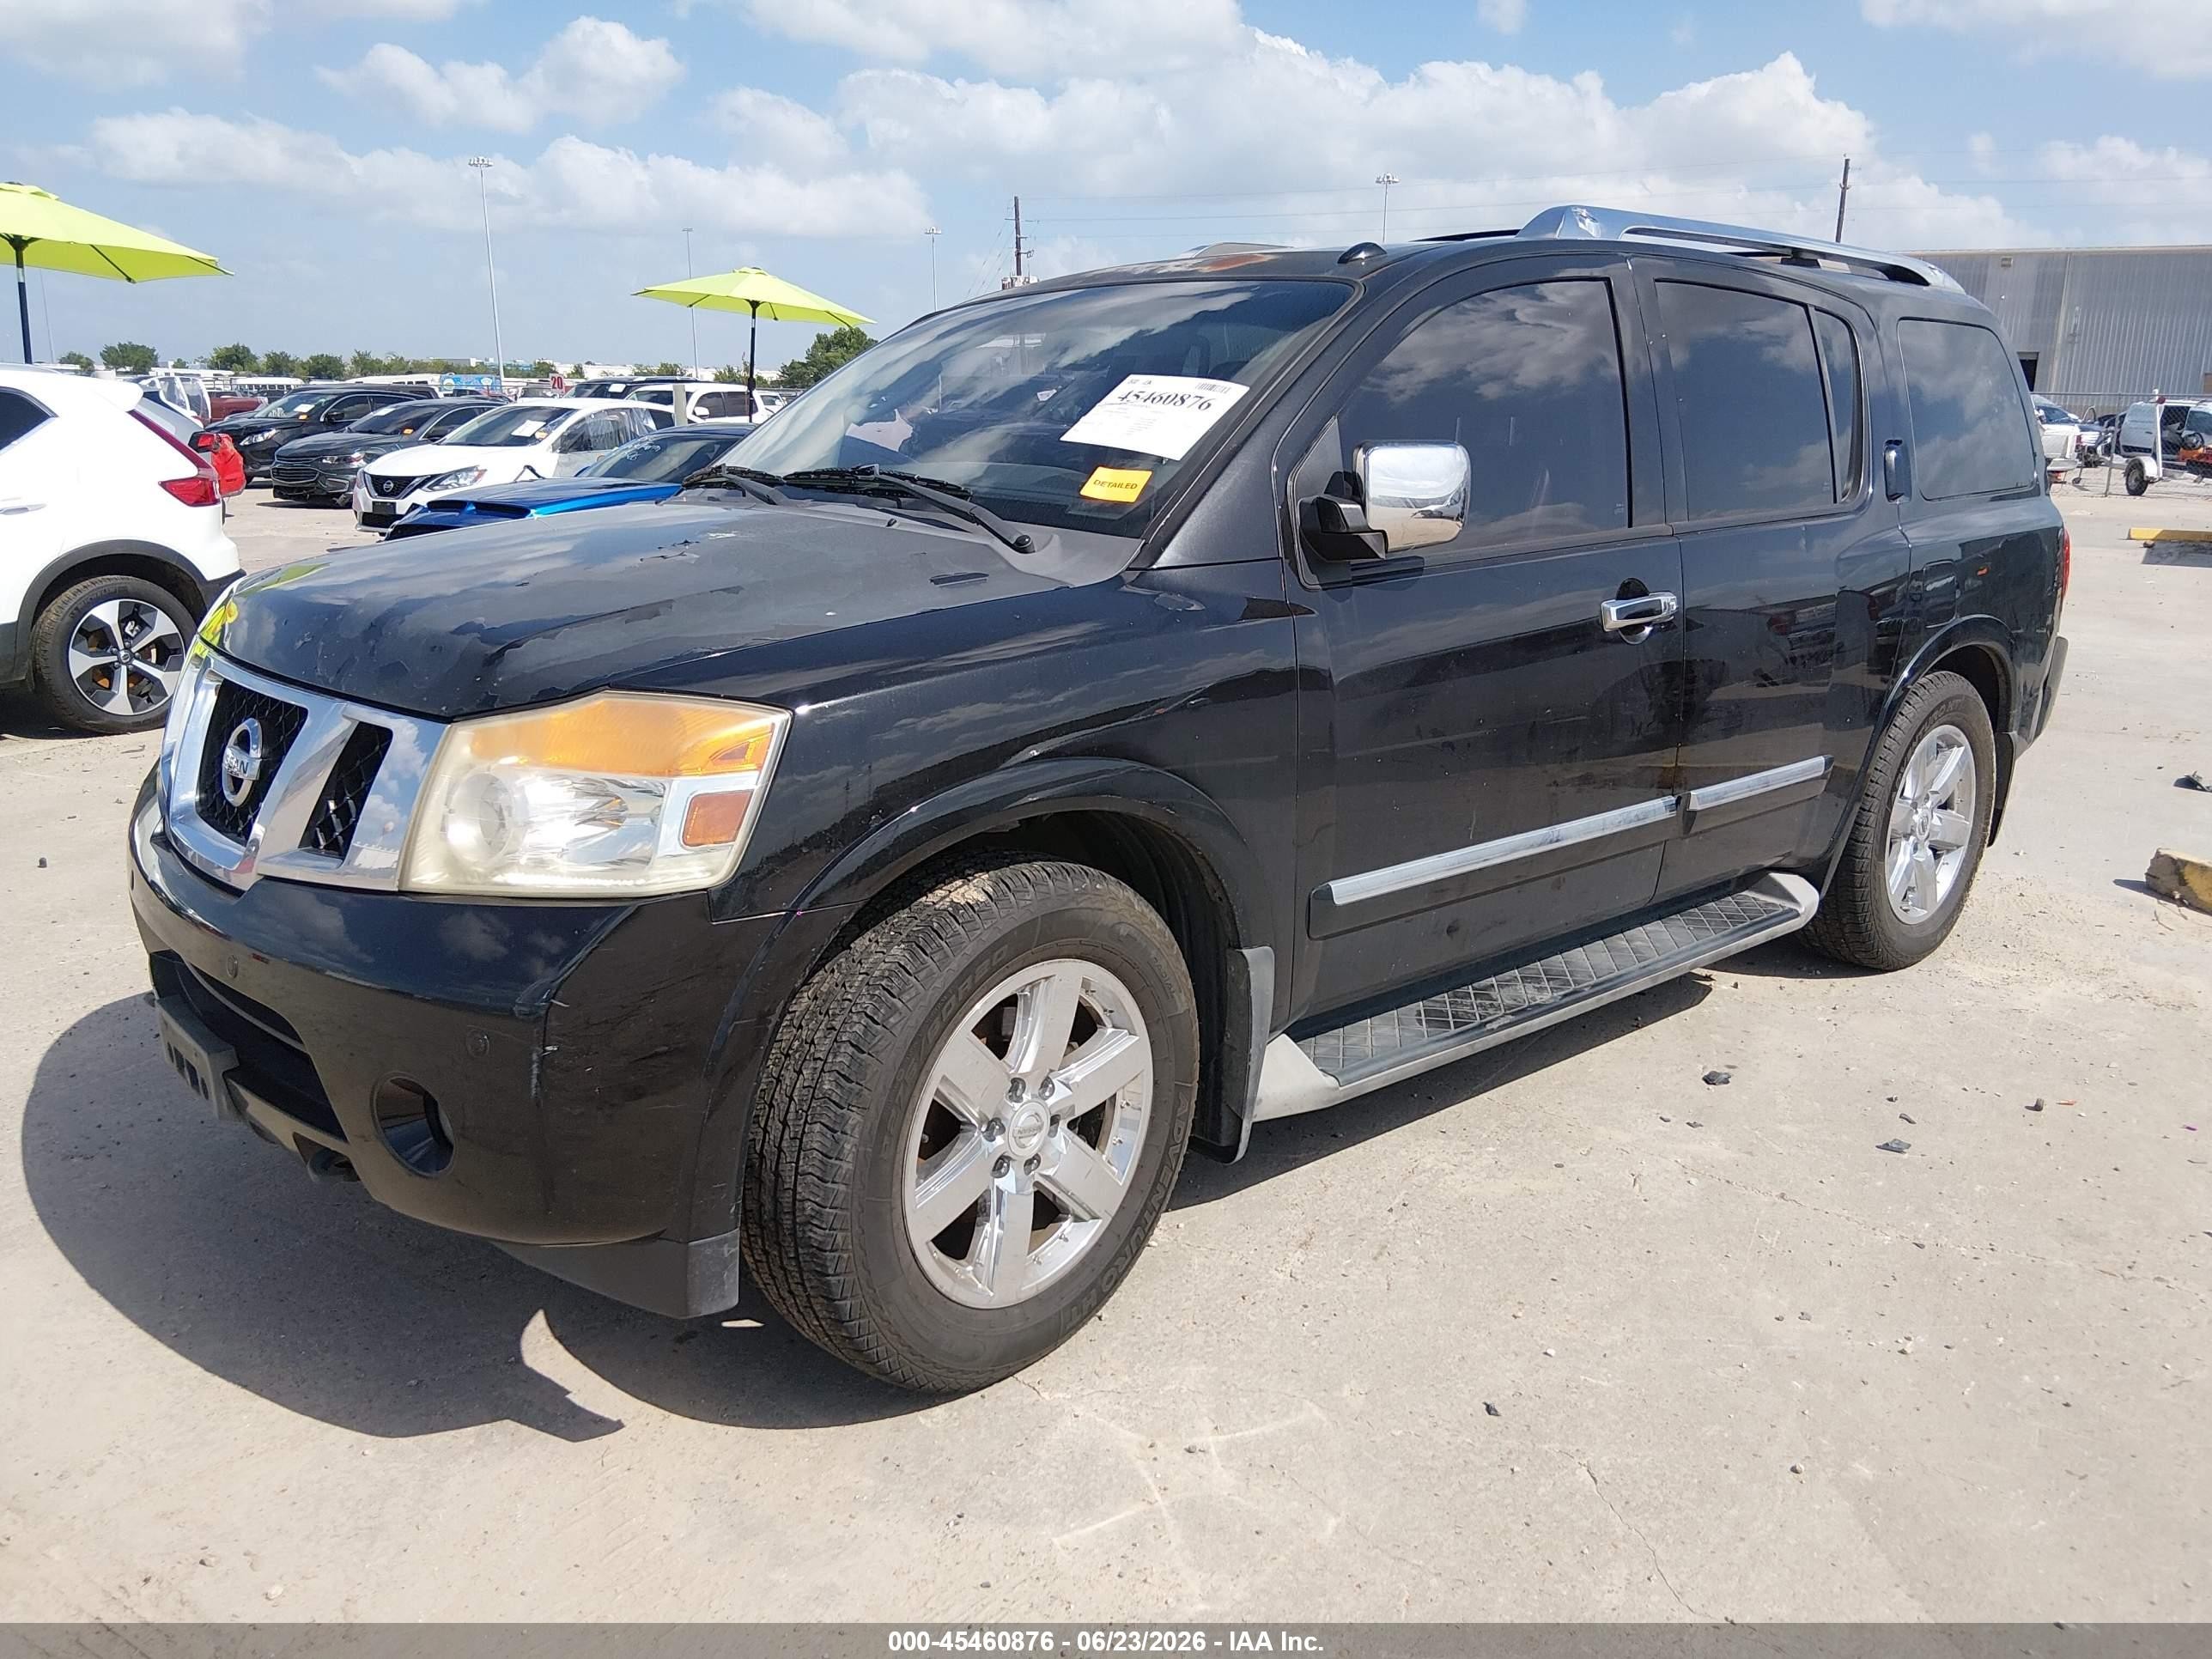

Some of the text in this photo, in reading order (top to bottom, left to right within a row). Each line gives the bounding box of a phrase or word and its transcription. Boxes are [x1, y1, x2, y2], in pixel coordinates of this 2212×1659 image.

[550, 376, 563, 389] 20
[1117, 390, 1217, 411] 45460876
[1093, 479, 1138, 489] DETAILED
[1101, 1091, 1190, 1286] ADVENTURO
